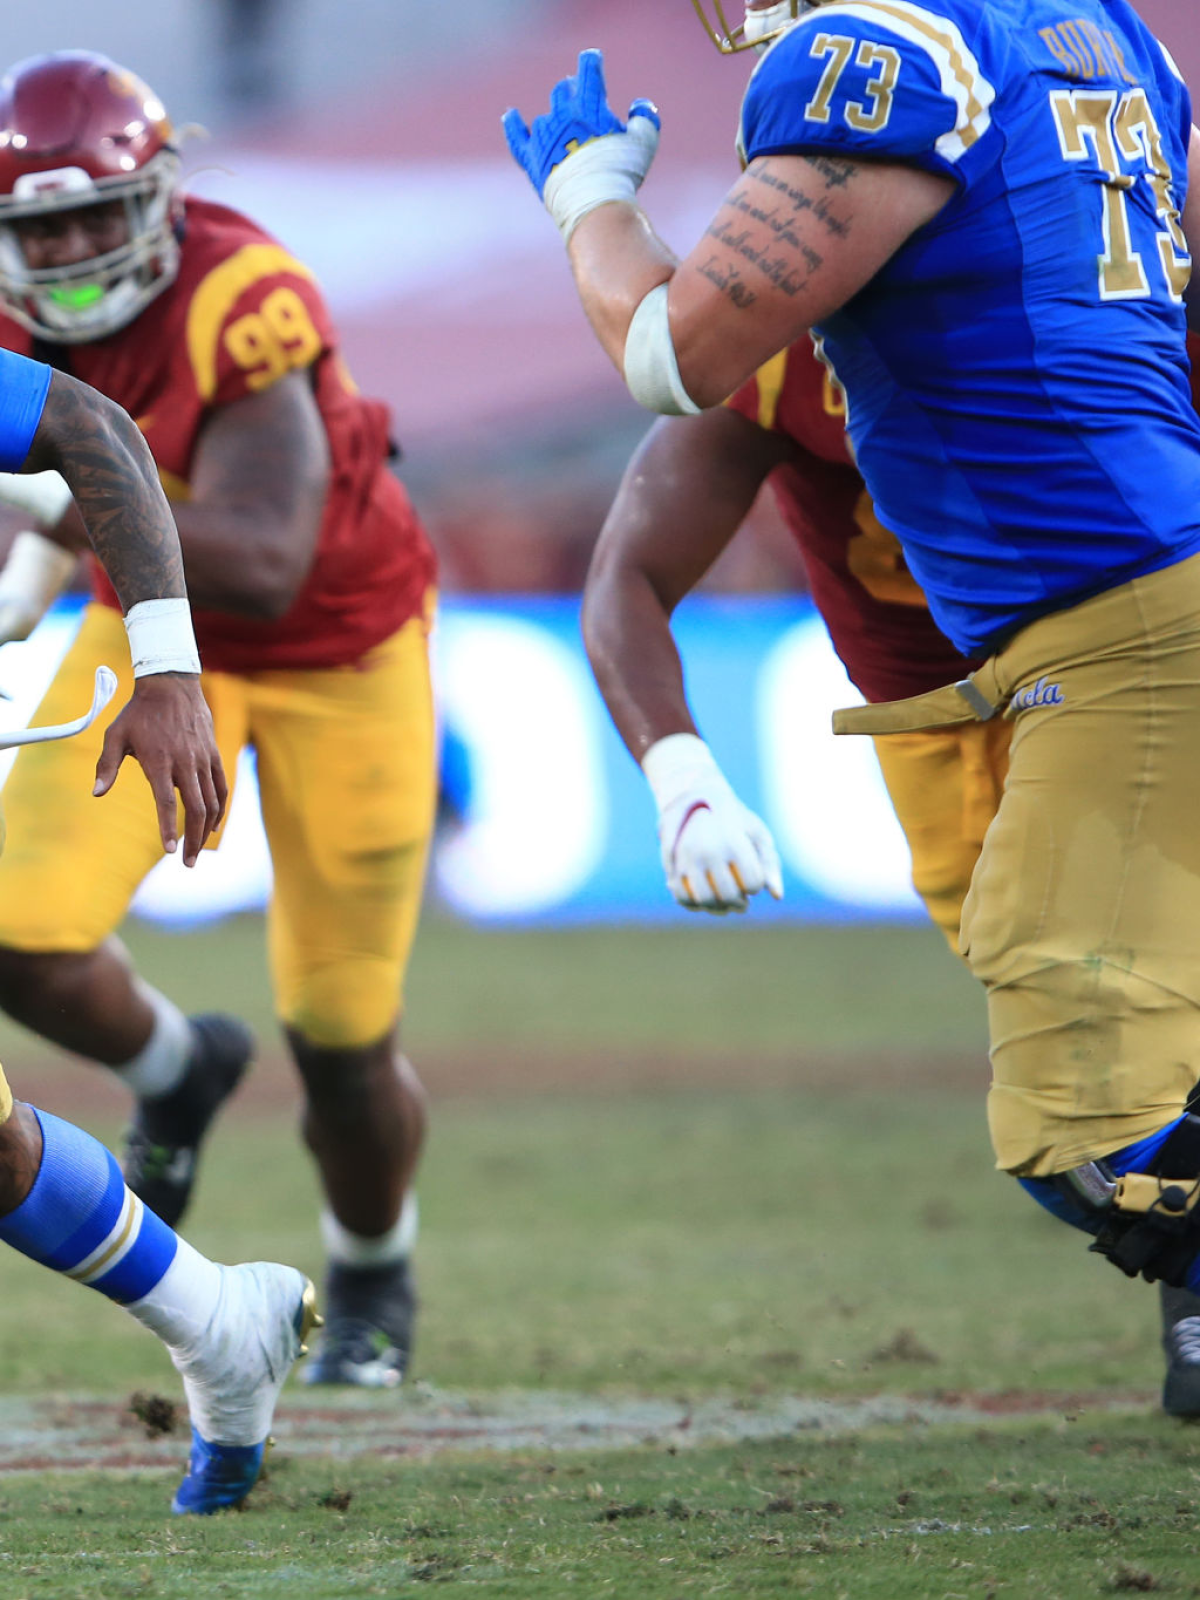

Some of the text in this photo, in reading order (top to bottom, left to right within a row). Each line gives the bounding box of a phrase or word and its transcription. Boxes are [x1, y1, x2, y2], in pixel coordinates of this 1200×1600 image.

[804, 33, 902, 134] 73
[1049, 87, 1192, 303] 73
[225, 287, 321, 392] 99
